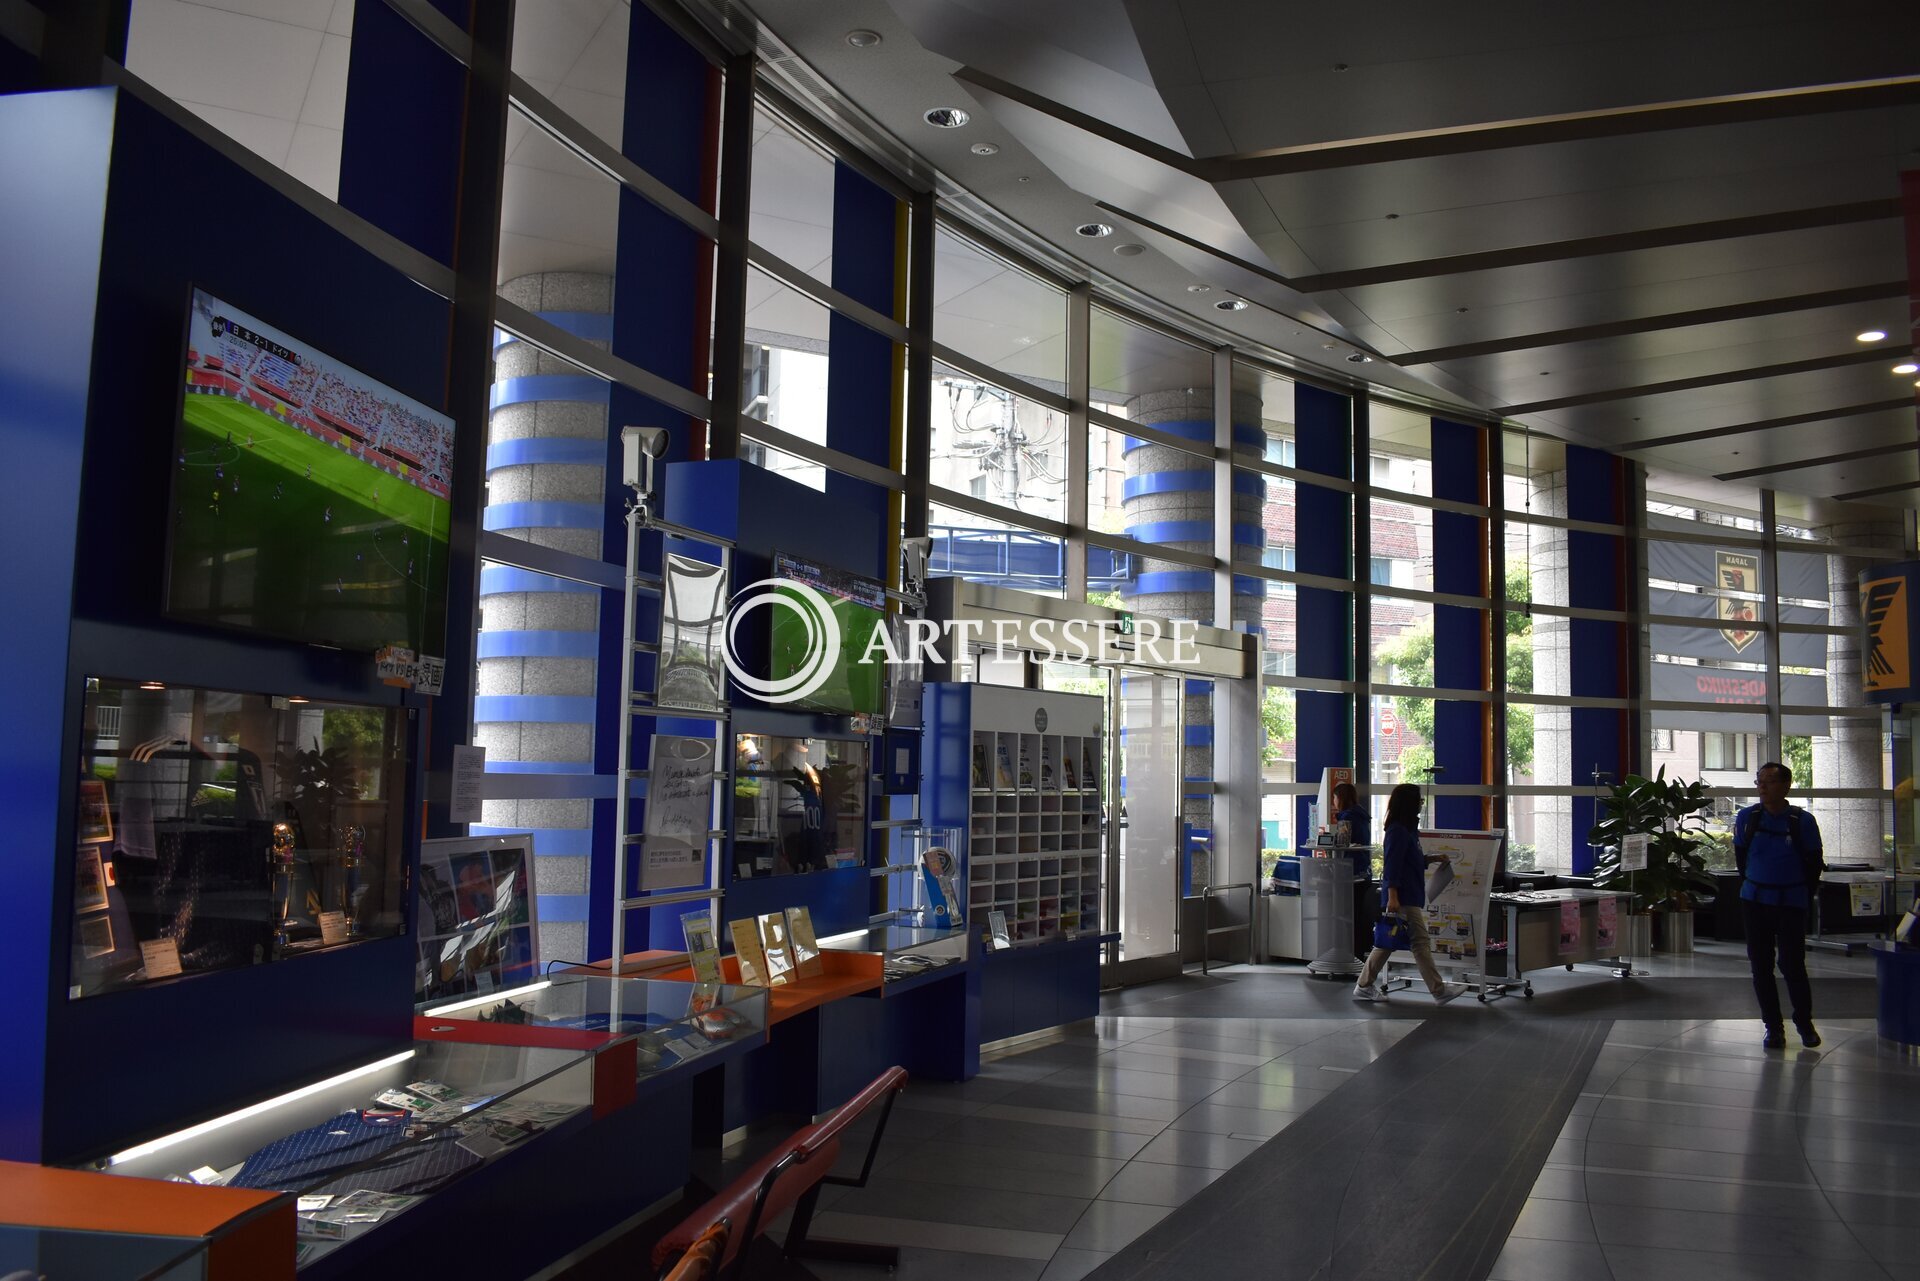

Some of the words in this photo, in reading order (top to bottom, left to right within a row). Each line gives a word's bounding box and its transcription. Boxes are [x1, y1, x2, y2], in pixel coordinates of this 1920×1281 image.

[254, 335, 268, 350] 2-1
[272, 344, 289, 358] ドイツ
[1334, 770, 1349, 780] AED
